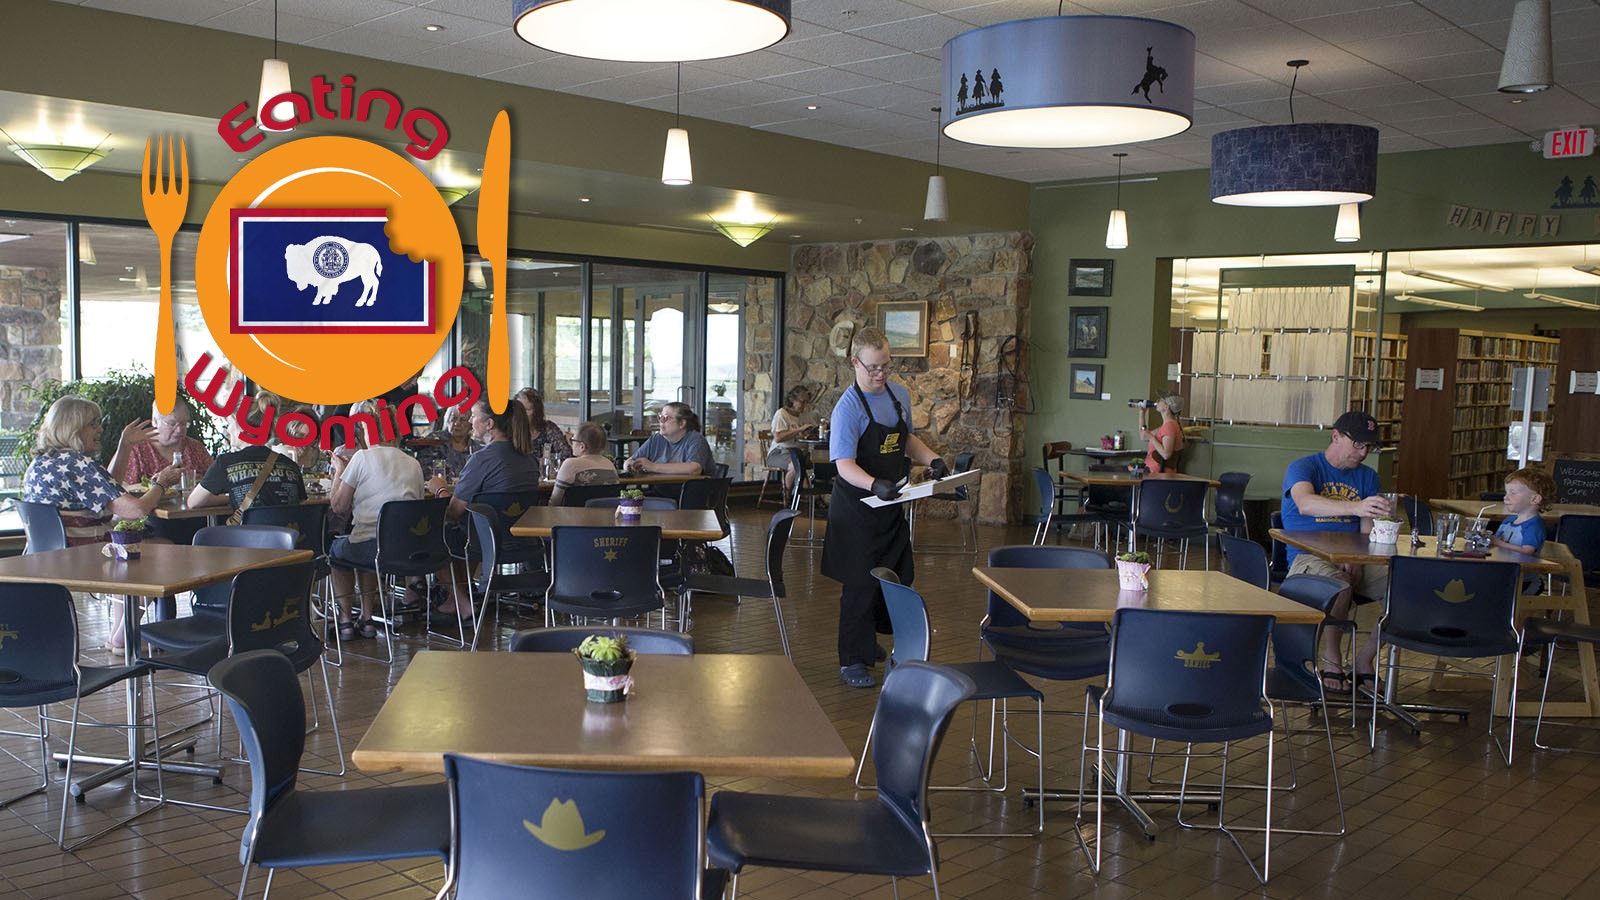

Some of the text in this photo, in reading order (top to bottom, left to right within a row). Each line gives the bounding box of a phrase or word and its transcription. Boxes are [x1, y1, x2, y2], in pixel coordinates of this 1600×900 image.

[1551, 129, 1588, 156] EXIT
[1449, 207, 1557, 231] HAPPY
[227, 469, 260, 483] WHAT
[593, 537, 629, 547] SHERIFF
